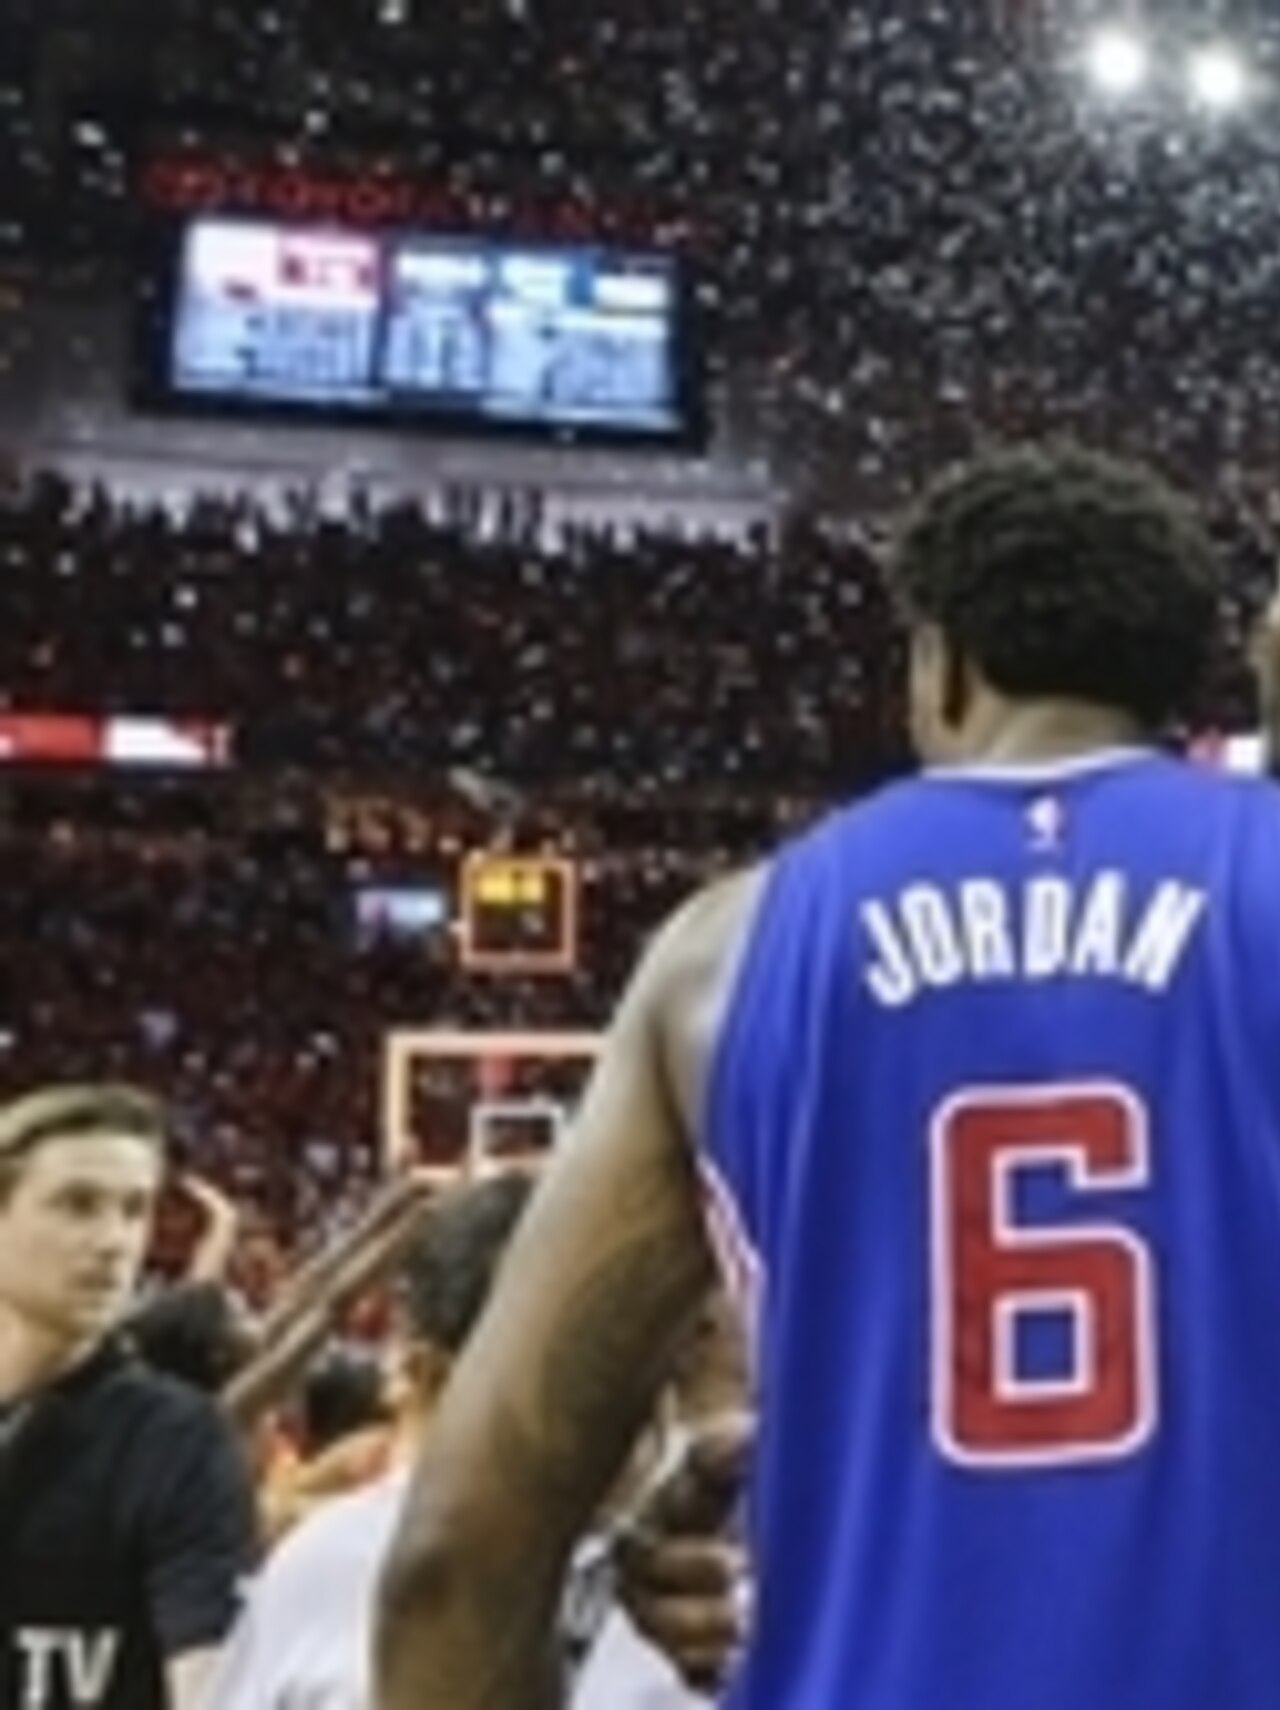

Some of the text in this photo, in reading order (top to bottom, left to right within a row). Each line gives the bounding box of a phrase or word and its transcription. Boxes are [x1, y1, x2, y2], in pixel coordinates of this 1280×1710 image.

[860, 869, 1206, 1006] JORDAN
[931, 1081, 1157, 1466] 6
[17, 1625, 120, 1710] TV
